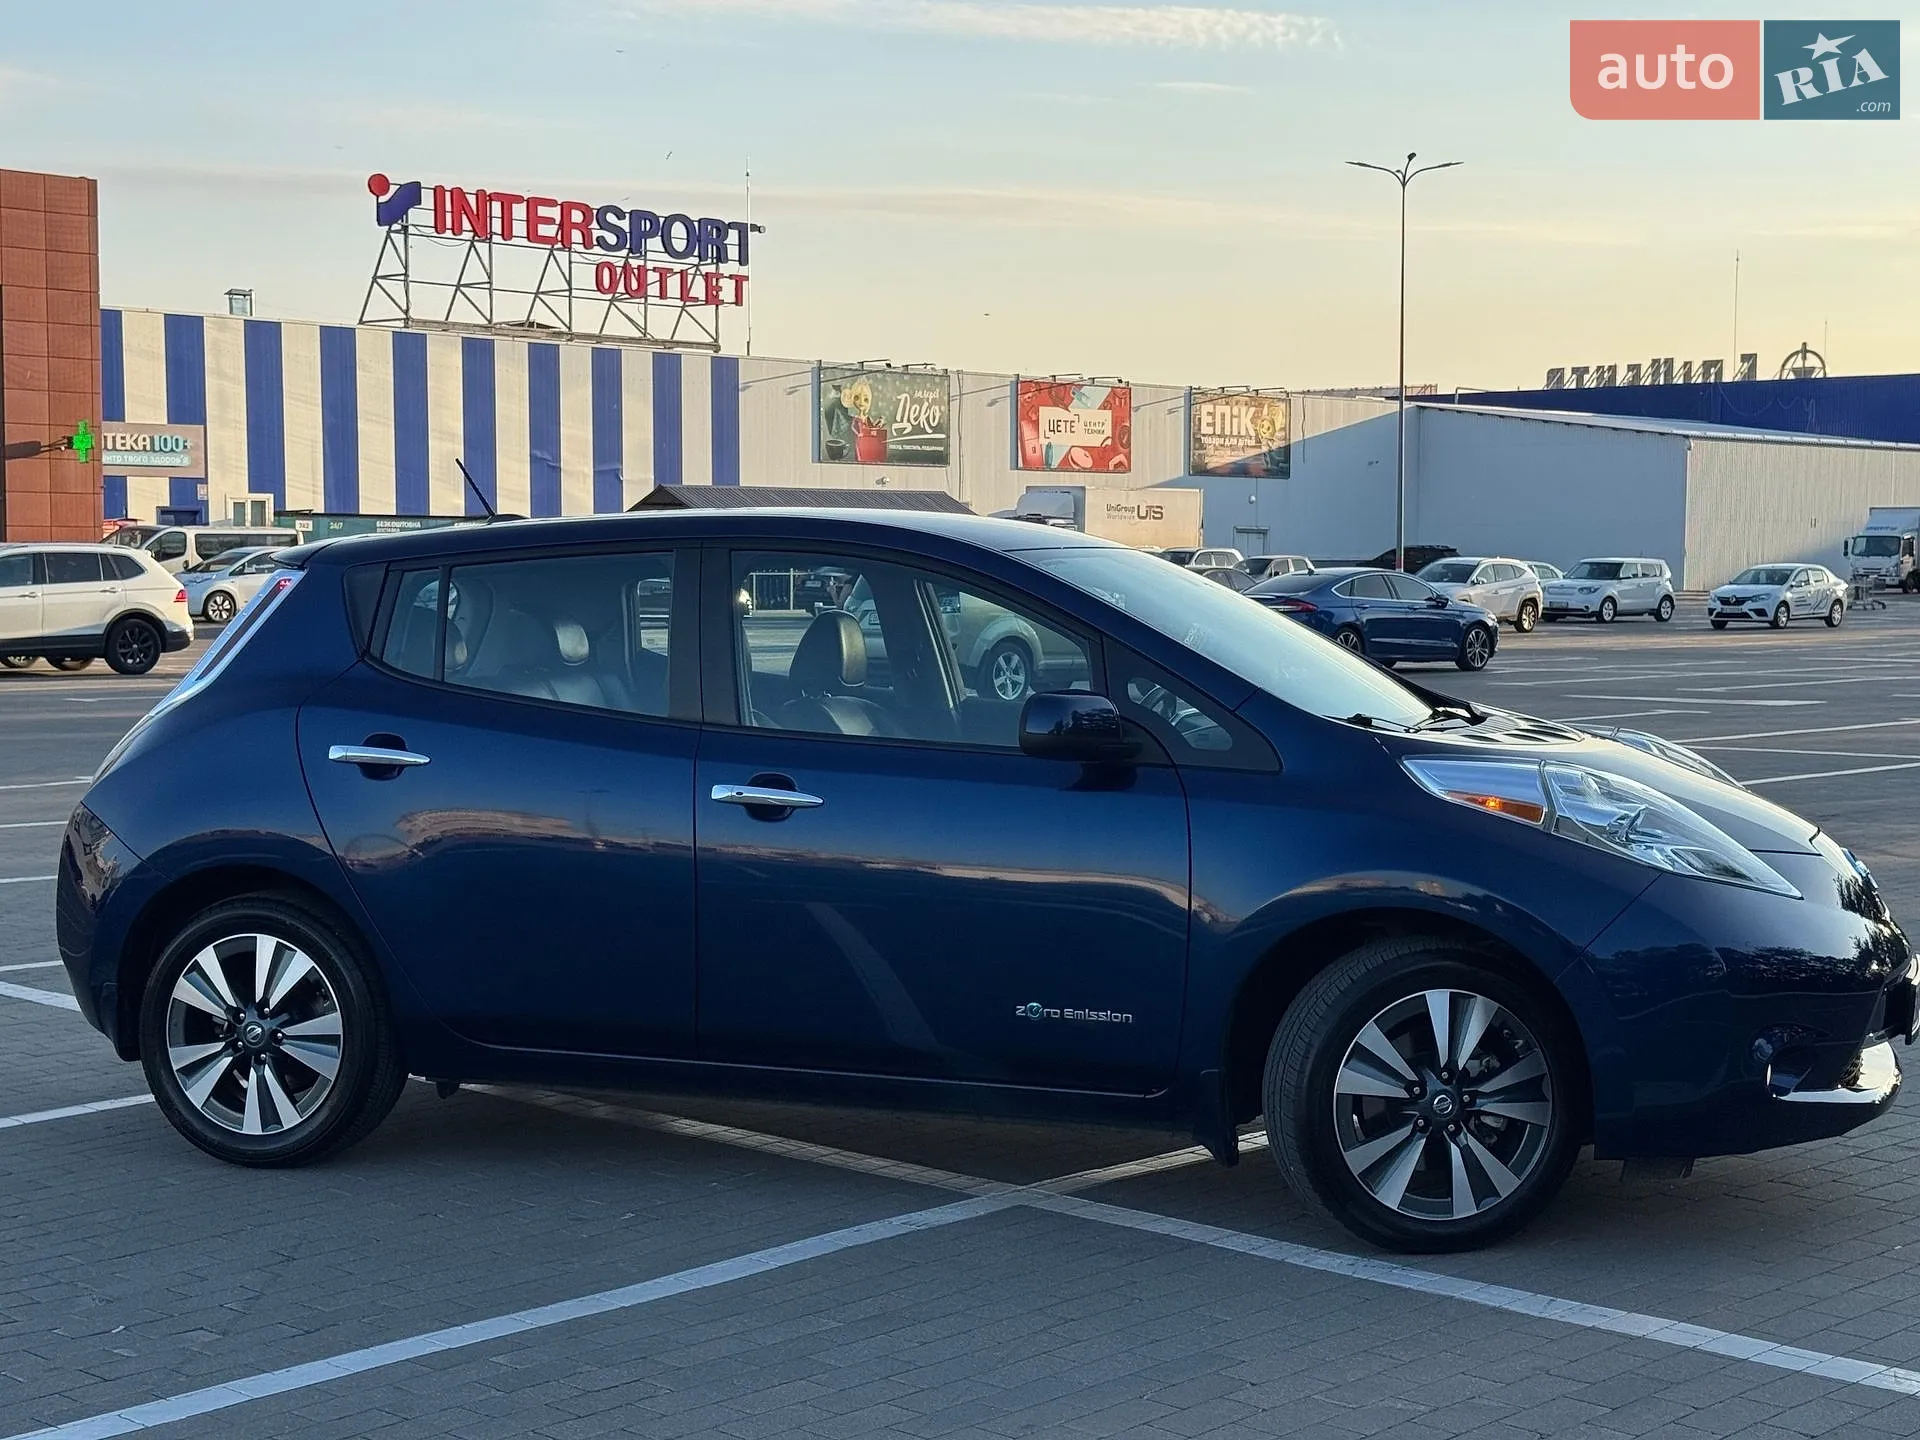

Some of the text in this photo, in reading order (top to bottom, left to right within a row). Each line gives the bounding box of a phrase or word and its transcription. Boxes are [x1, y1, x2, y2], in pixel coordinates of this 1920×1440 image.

[433, 184, 750, 267] INTERSPORT
[595, 260, 749, 307] OUTLET
[1048, 418, 1076, 435] ЦЕТЕ
[102, 432, 151, 451] ТЕКА
[1106, 503, 1136, 514] UniGroup
